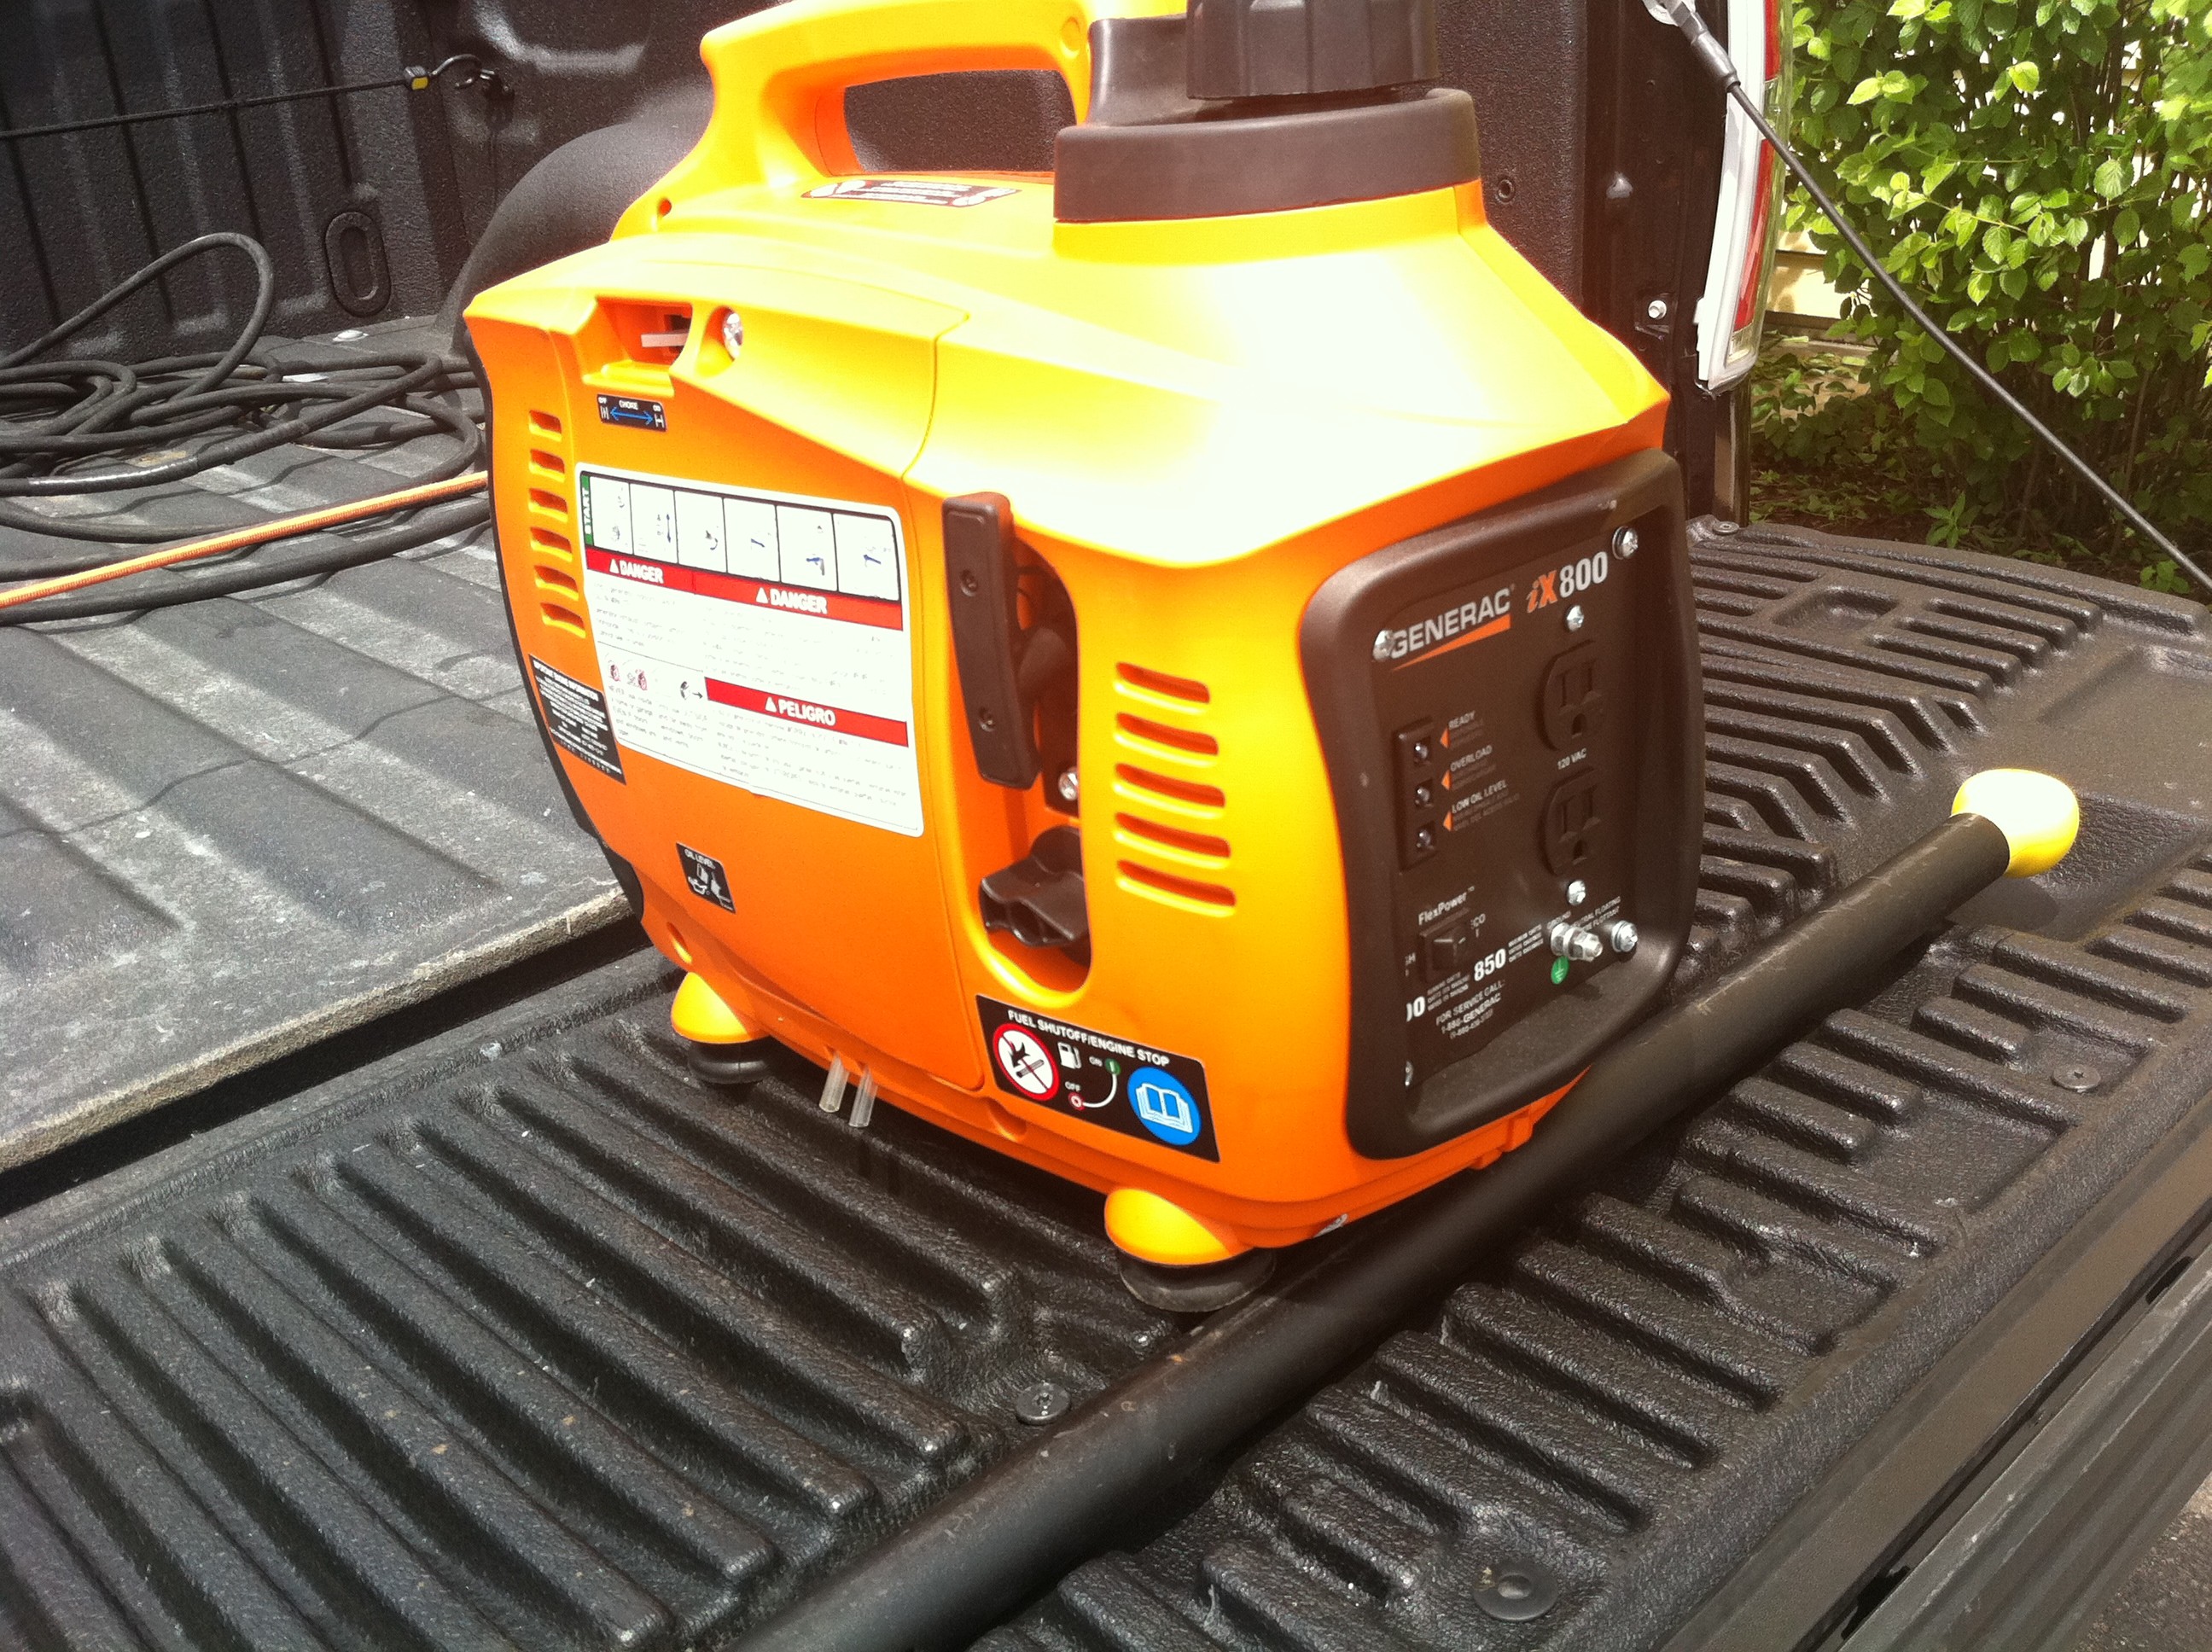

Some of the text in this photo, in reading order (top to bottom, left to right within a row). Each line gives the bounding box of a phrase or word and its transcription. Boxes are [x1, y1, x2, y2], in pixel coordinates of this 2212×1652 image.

[583, 485, 592, 535] START
[619, 560, 664, 584] DANGER
[770, 588, 828, 614] DANGER
[1389, 588, 1511, 659] GENERAC
[777, 699, 836, 726] PELIGRO
[1449, 711, 1475, 730] READY
[1451, 745, 1493, 771] OVERLOAD
[1557, 748, 1587, 770] 120 VAC
[1452, 780, 1507, 813] LOW OIL LEVEL
[696, 854, 715, 870] LEVEL
[1474, 949, 1506, 981] 850
[1435, 1009, 1452, 1026] FOR
[1452, 991, 1483, 1015] SERVICE
[1008, 1010, 1170, 1067] FUEL SHUTOFF/ENGINE STOP
[1065, 1081, 1081, 1092] OFF
